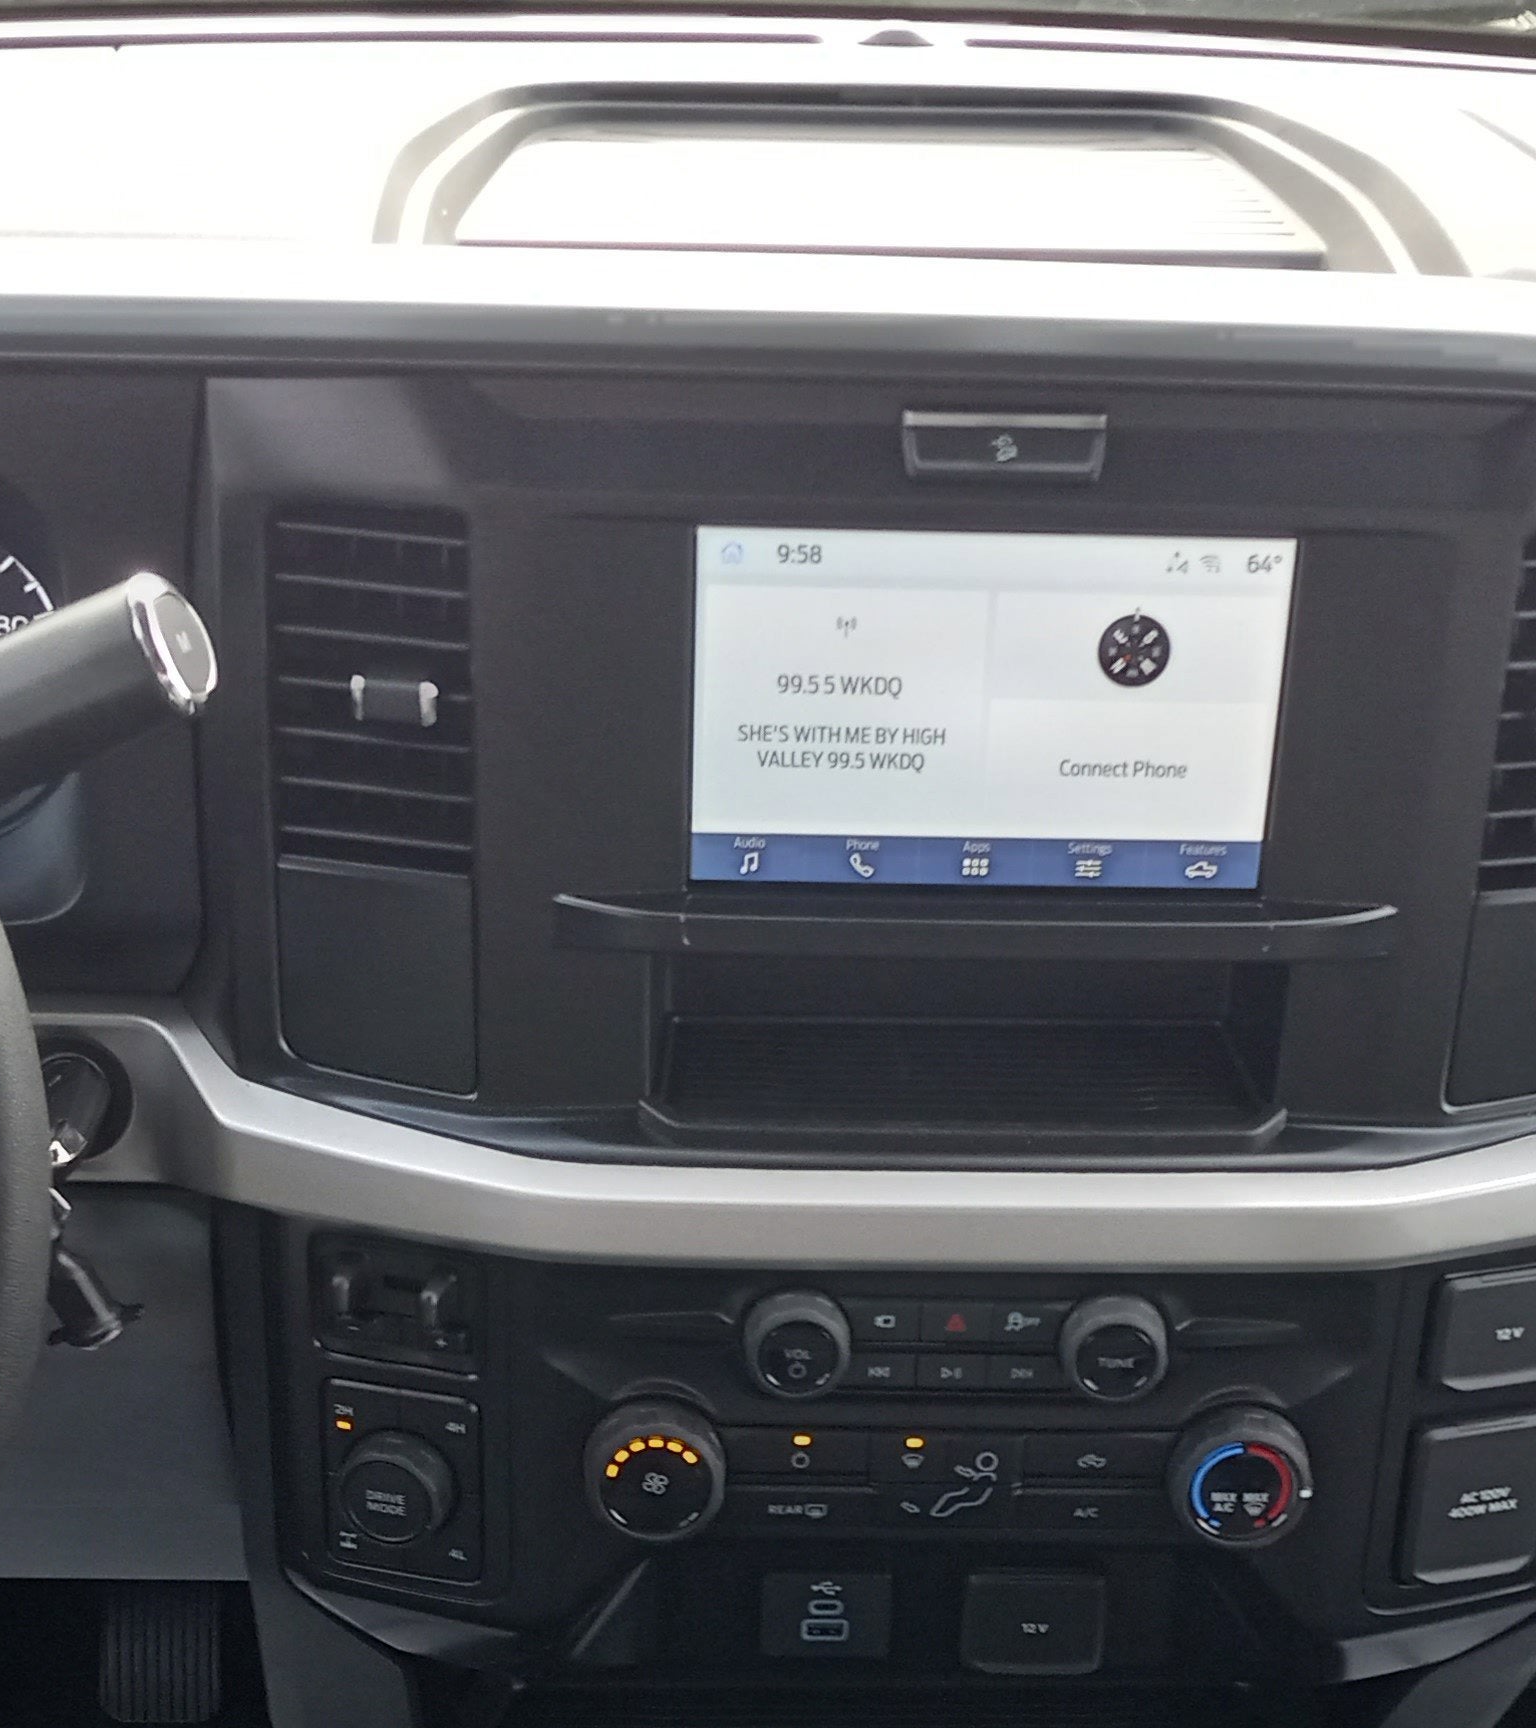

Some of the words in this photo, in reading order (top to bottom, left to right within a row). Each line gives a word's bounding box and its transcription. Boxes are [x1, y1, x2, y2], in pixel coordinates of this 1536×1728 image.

[777, 544, 822, 564] 9:58
[777, 674, 819, 695] 99.5
[823, 675, 835, 695] 5
[840, 676, 902, 699] WKDQ
[737, 724, 789, 742] SHE'S
[793, 725, 841, 743] WITH
[844, 726, 870, 744] ME
[875, 727, 899, 744] BY
[902, 728, 946, 745] HIGH
[757, 750, 823, 768] VALLEY
[827, 751, 864, 769] 99.5
[869, 752, 925, 773] WKDQ
[1059, 759, 1126, 778] Connect
[1131, 760, 1188, 779] Phone
[734, 837, 766, 849] Audio
[846, 839, 880, 851] Phone
[963, 841, 991, 853] Apps
[1067, 842, 1113, 856] Settings
[1179, 843, 1228, 856] Features
[768, 1505, 802, 1515] REAR
[1073, 1507, 1099, 1519] A/C
